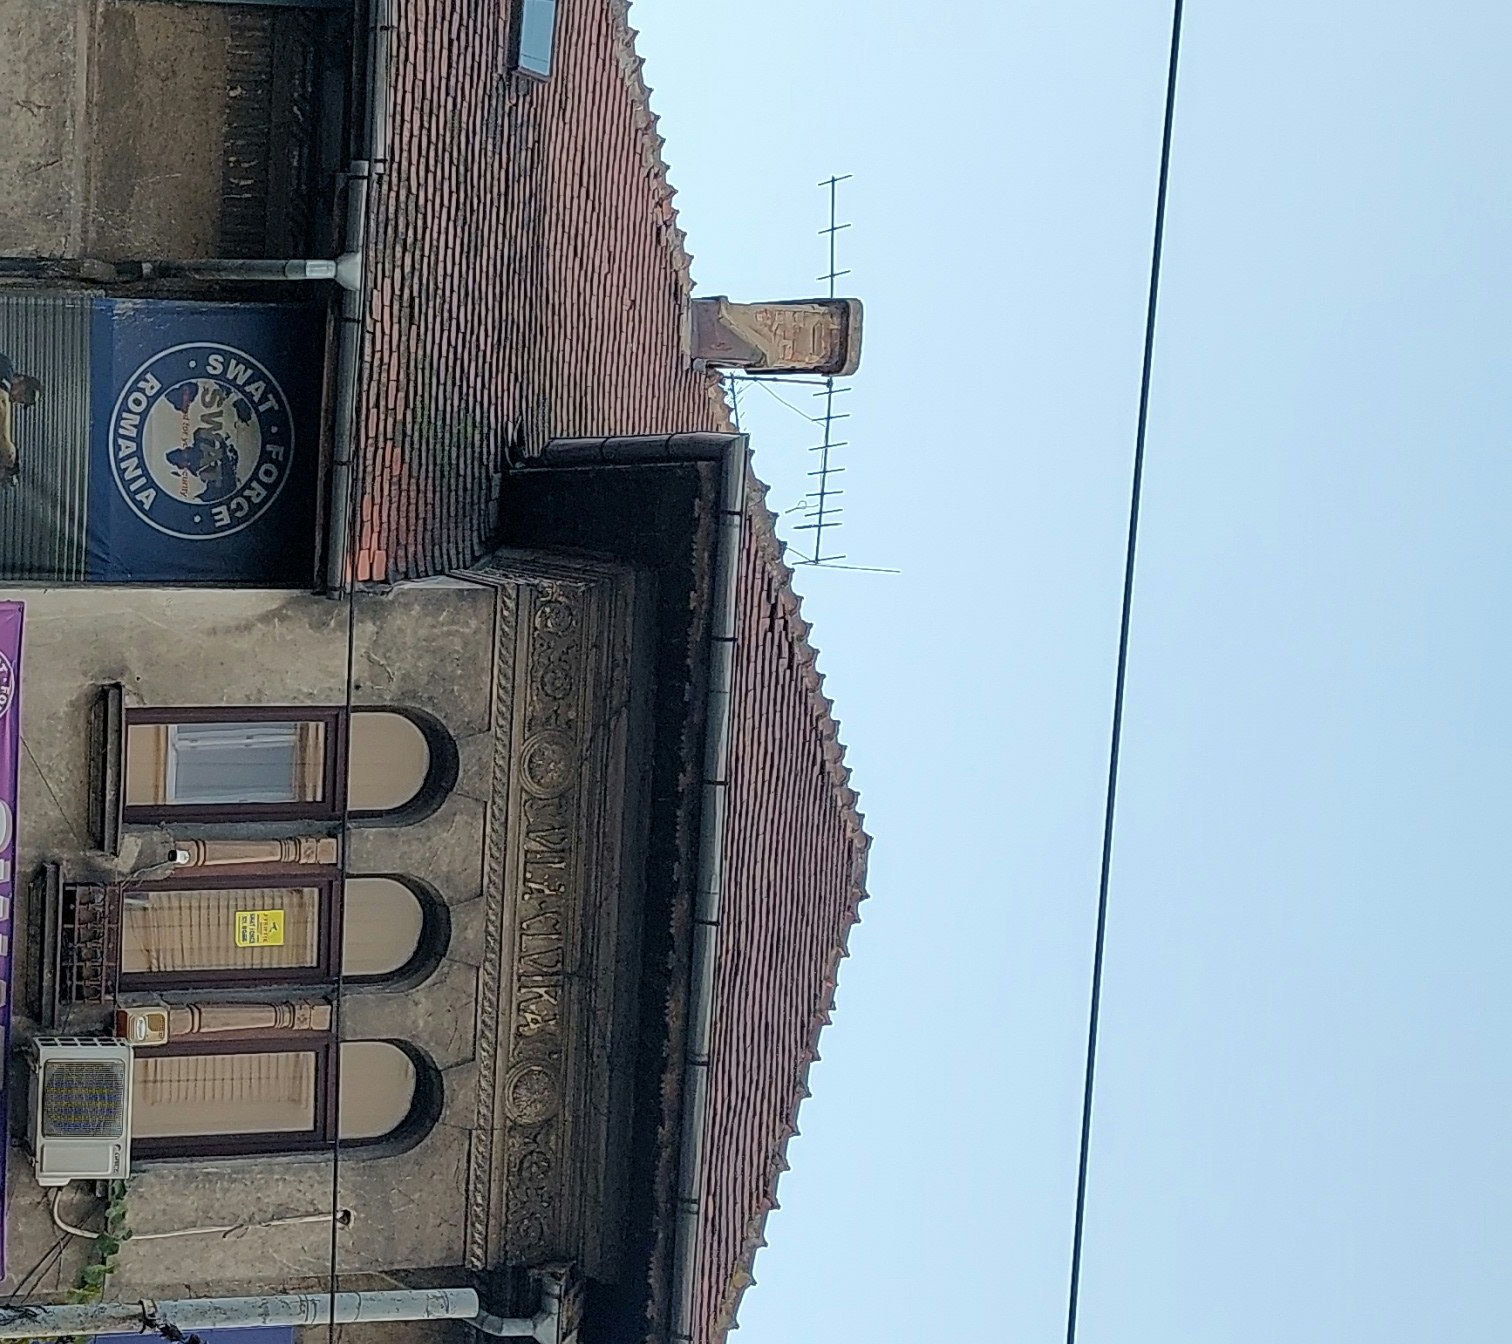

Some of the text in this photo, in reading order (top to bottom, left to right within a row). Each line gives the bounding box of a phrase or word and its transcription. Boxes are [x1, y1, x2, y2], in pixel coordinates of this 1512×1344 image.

[117, 372, 162, 511] ROMANIA
[206, 355, 285, 527] SWAT FORCE
